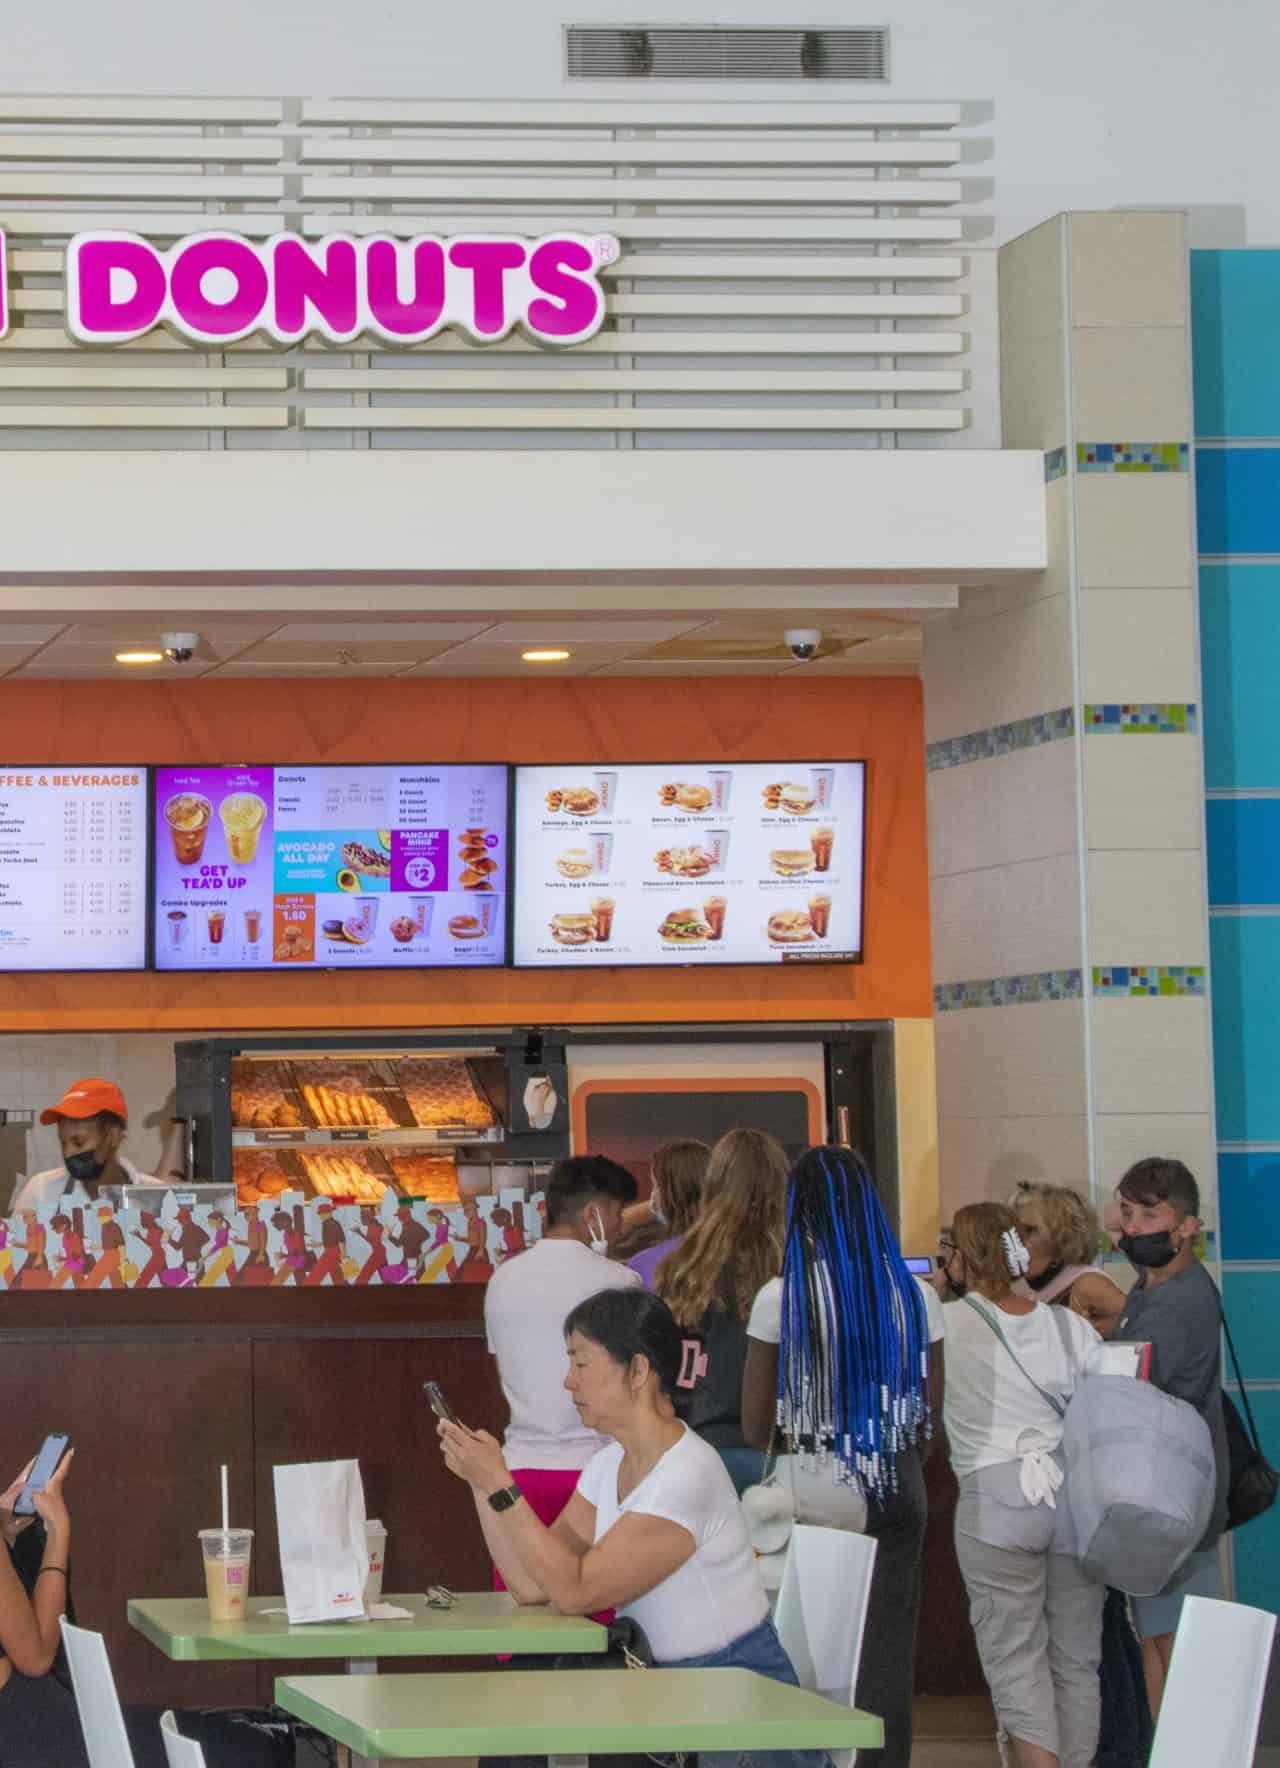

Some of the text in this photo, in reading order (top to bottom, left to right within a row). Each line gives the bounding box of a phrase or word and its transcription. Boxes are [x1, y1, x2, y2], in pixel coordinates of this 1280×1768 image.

[78, 238, 598, 336] DONUTS
[38, 776, 48, 787] &
[53, 775, 139, 786] BEVERAGES
[400, 832, 439, 840] PANCAKE
[278, 843, 336, 852] AVOCADO
[283, 853, 329, 863] ALL DAY
[200, 866, 228, 876] GET
[181, 878, 247, 889] TEA'D UP
